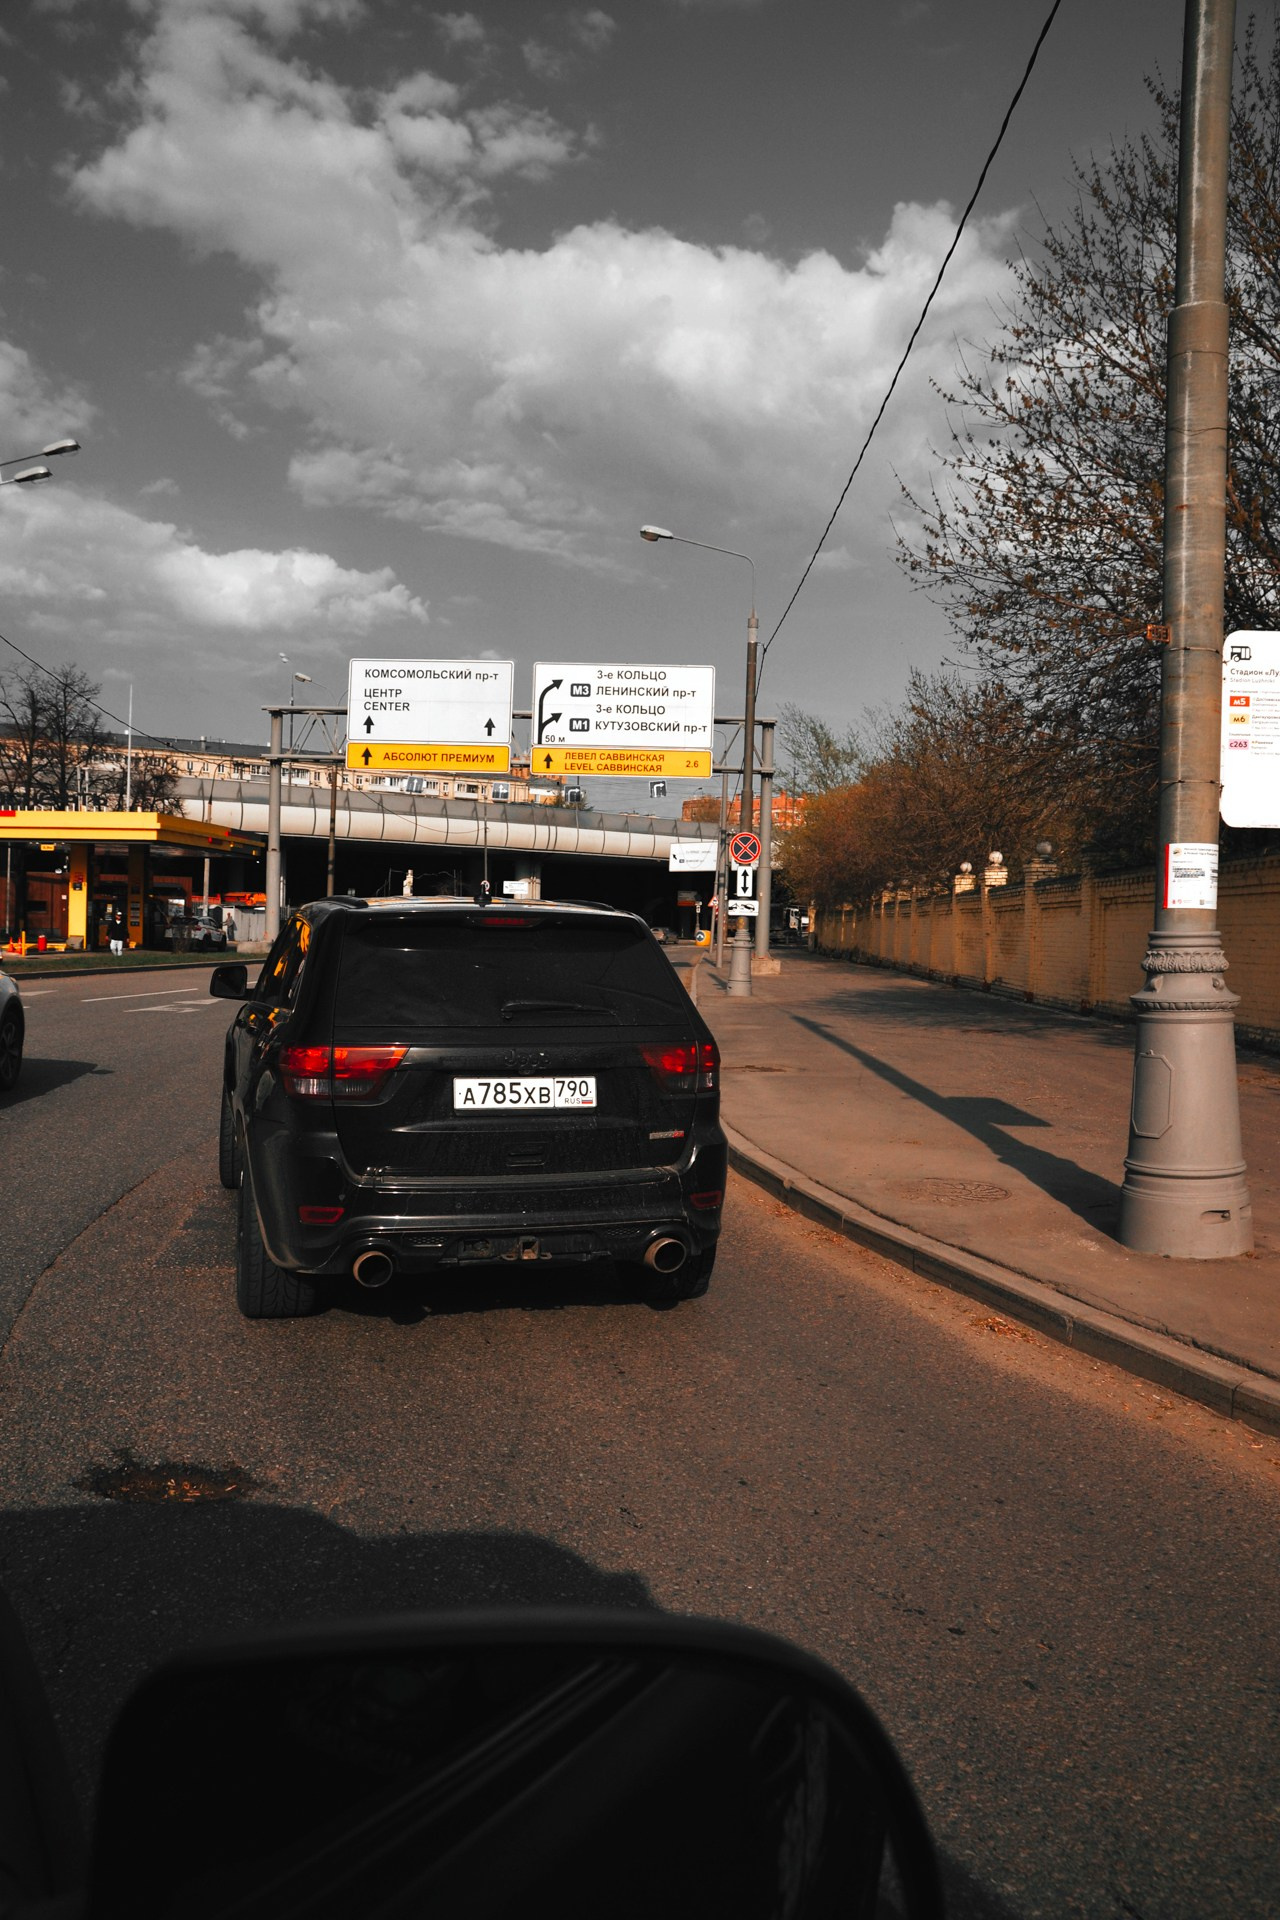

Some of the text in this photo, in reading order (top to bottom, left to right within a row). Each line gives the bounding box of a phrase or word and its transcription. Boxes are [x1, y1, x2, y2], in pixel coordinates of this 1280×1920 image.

[365, 669, 499, 682] КОМСОМОЛЬСКИЙ пр-т
[597, 670, 667, 682] 3-е КОЛЬЦО
[1230, 668, 1263, 676] Стадион
[364, 689, 402, 699] ЦЕНТР
[572, 685, 589, 695] М3
[596, 686, 696, 699] ЛЕНИНСКИЙ пр-т
[363, 701, 410, 711] CENTER
[596, 704, 666, 716] 3-е КОЛЬЦО
[572, 720, 588, 730] М1
[595, 721, 708, 734] КУТУЗОВСКИЙ пр-т
[545, 735, 556, 743] 50
[383, 752, 495, 763] АБСОЛЮТ ПРЕМИУМ
[564, 752, 665, 762] ЛЕВЕЛ САВВИНСКАЯ
[564, 762, 662, 773] LEVEL САВВИНСКАЯ
[686, 760, 699, 768] 2.6
[463, 1080, 589, 1104] А785ХВ 790
